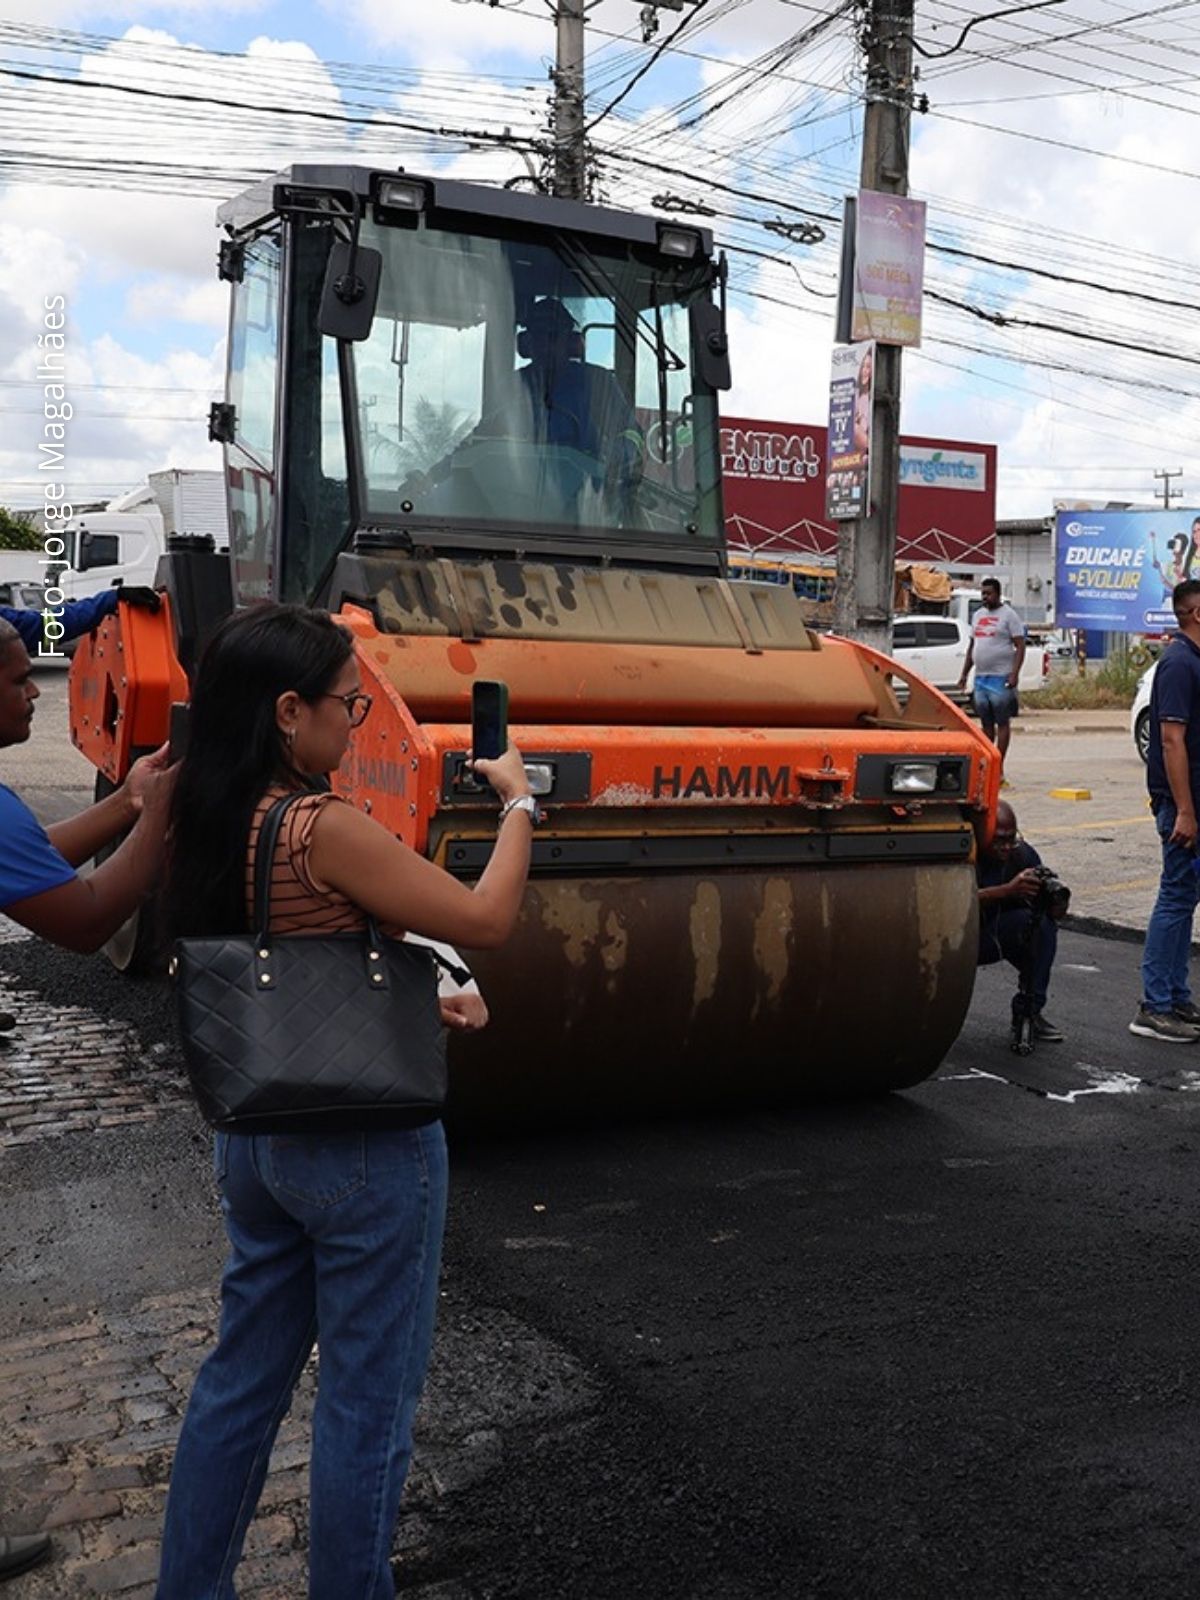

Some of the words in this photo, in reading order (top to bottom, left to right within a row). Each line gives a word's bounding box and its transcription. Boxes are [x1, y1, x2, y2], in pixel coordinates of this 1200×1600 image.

[834, 417, 849, 433] TV
[719, 428, 821, 465] ENTRAL
[733, 456, 818, 477] ADUBOS
[900, 458, 978, 483] yngenta
[1065, 546, 1133, 567] EDUCAR
[1132, 544, 1147, 567] É
[1076, 567, 1142, 590] EVOLUIR
[357, 755, 407, 799] HAMM
[652, 765, 791, 799] HAMM
